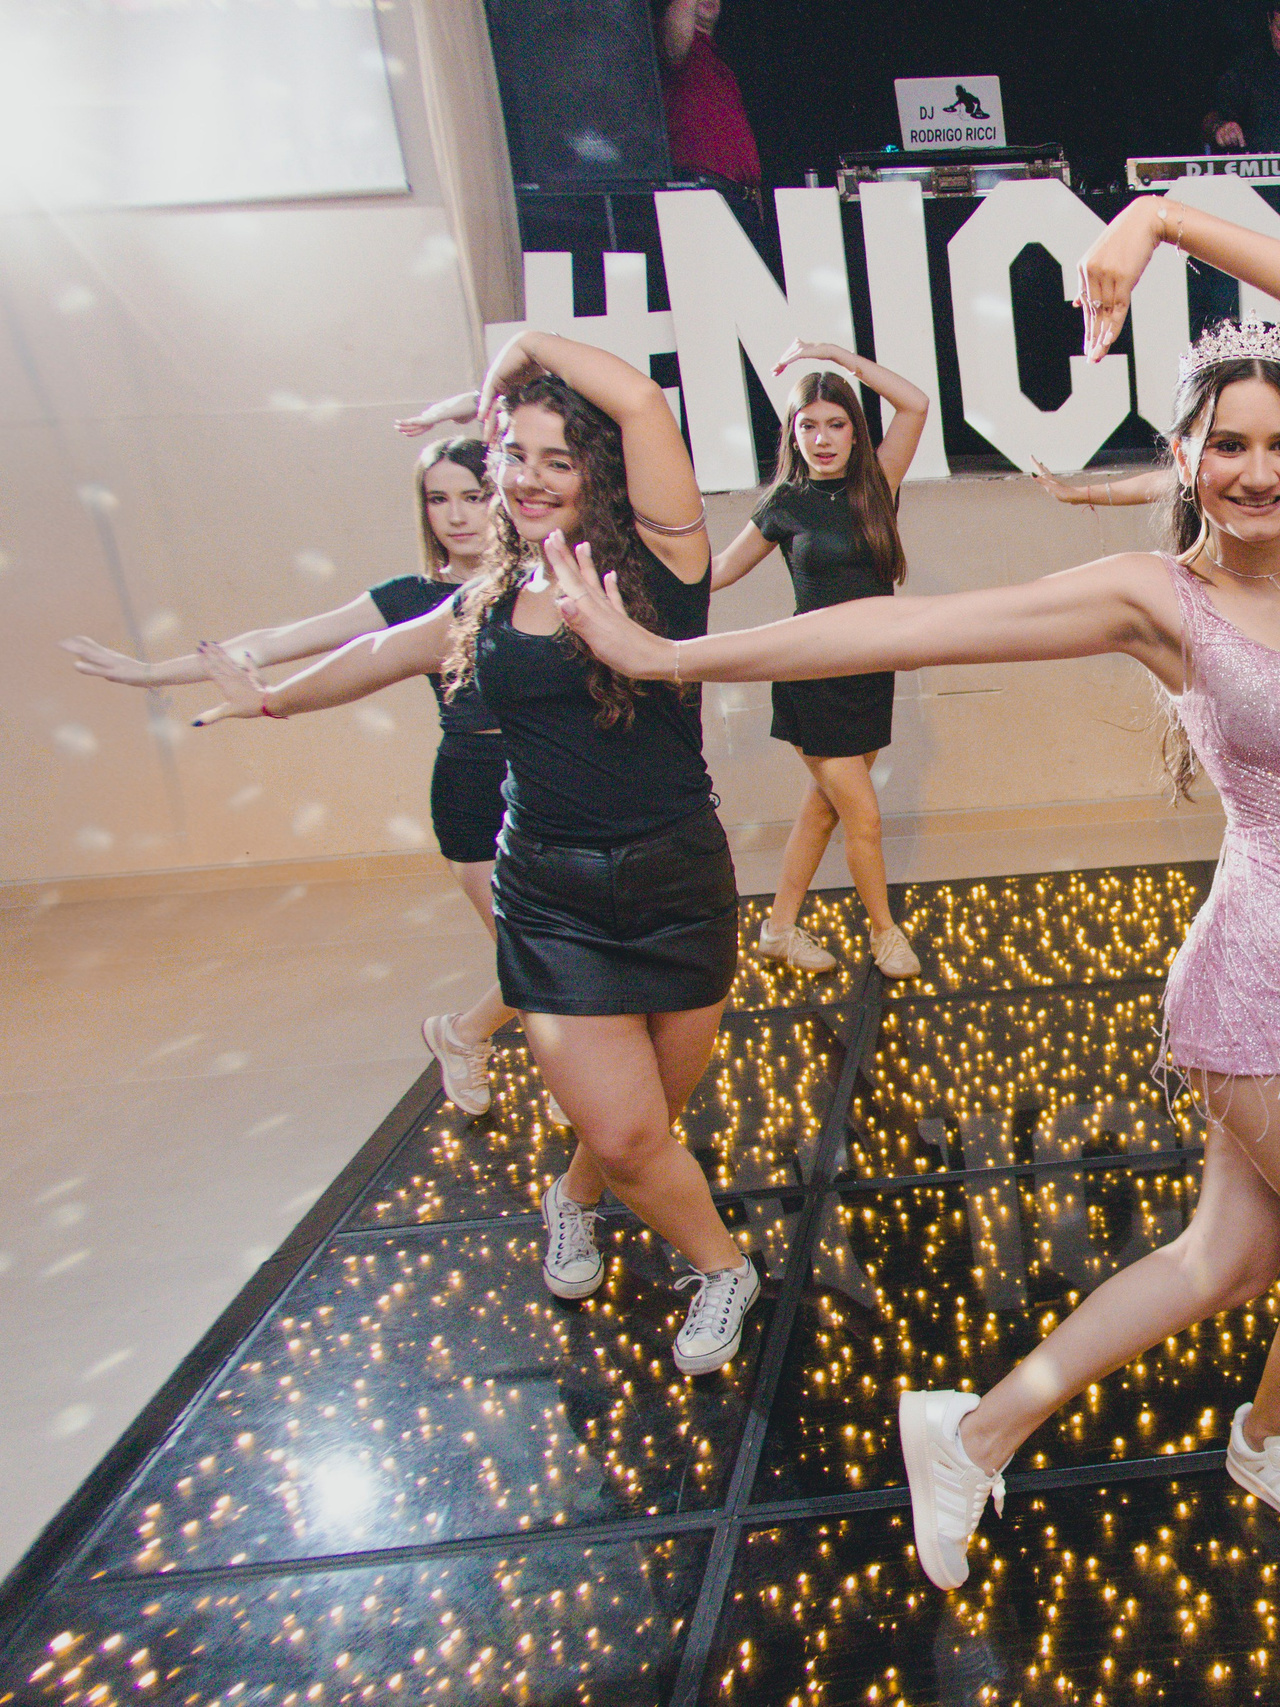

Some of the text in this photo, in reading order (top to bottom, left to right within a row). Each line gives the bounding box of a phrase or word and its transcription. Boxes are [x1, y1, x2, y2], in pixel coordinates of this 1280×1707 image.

[919, 106, 935, 120] DJ
[910, 127, 996, 143] RODRIGO RICCI
[1186, 163, 1214, 177] DJ
